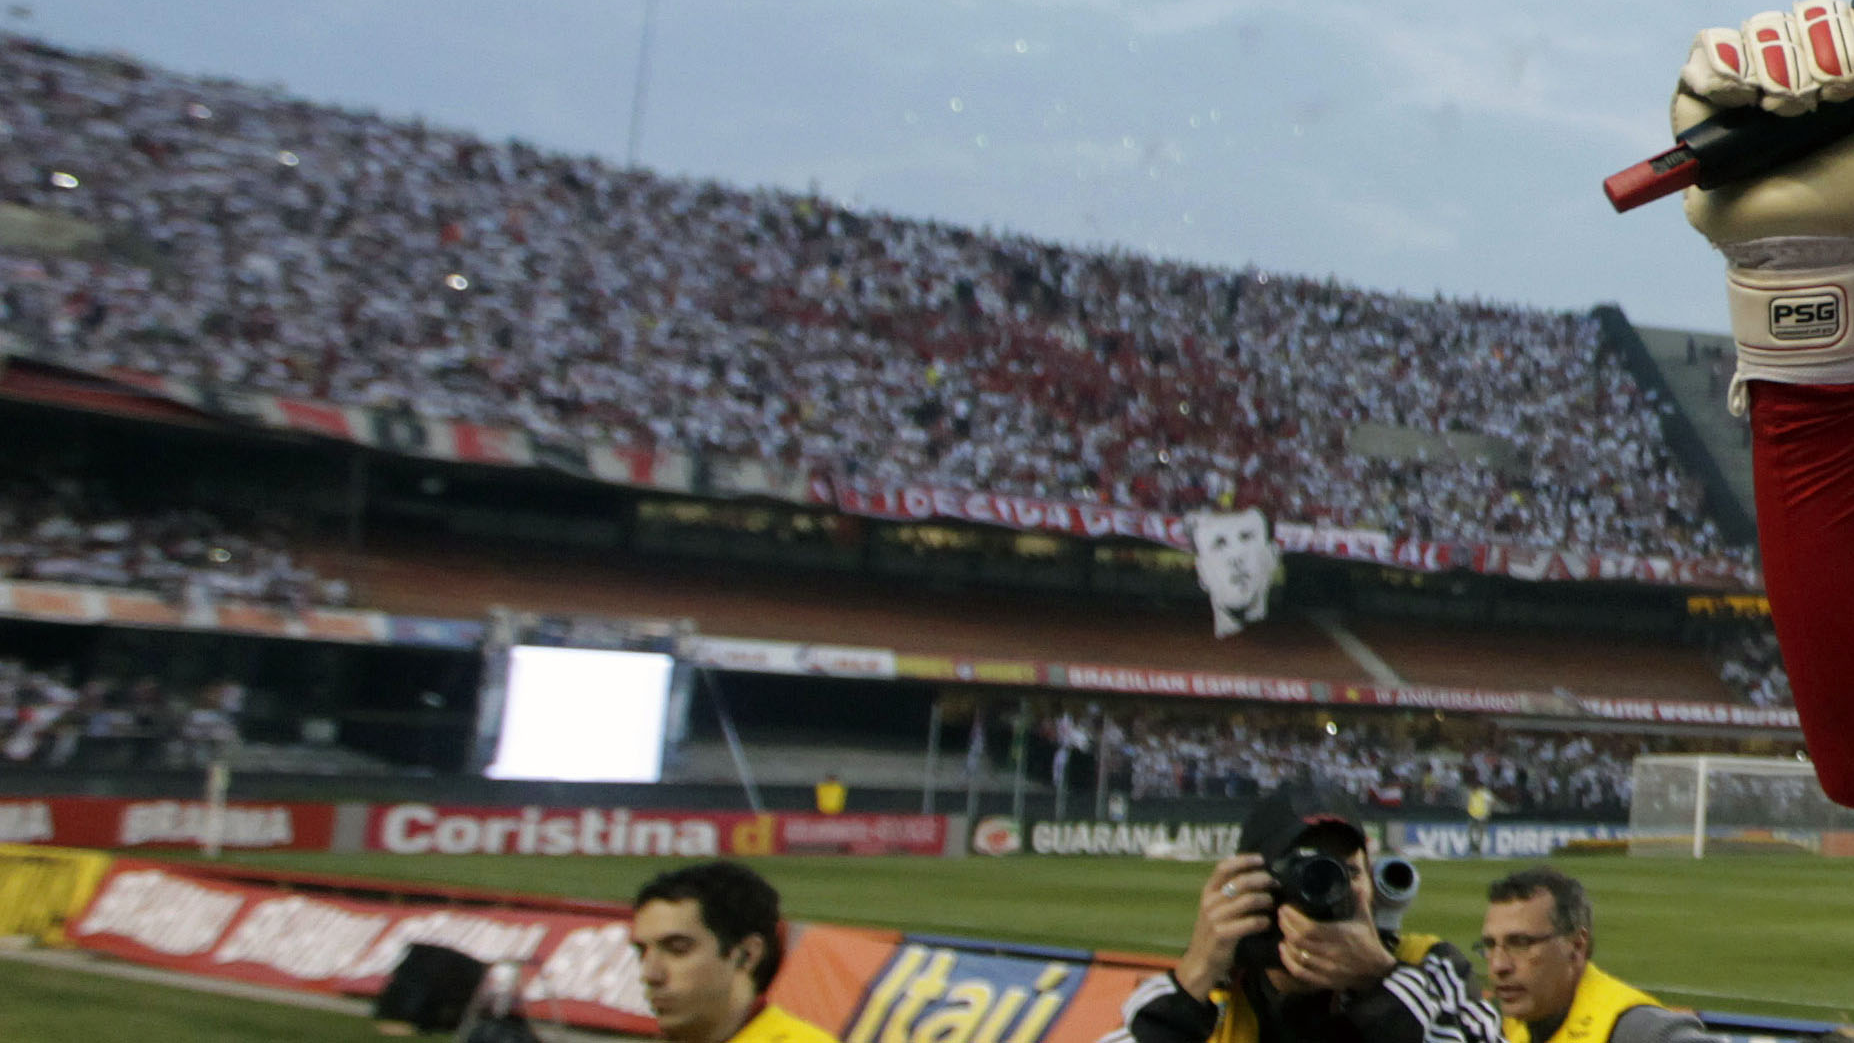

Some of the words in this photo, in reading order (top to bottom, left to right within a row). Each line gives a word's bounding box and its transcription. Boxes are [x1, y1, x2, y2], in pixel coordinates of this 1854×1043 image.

[1773, 302, 1835, 324] PSG
[381, 803, 718, 857] Coristina
[848, 943, 1068, 1043] Itaú
